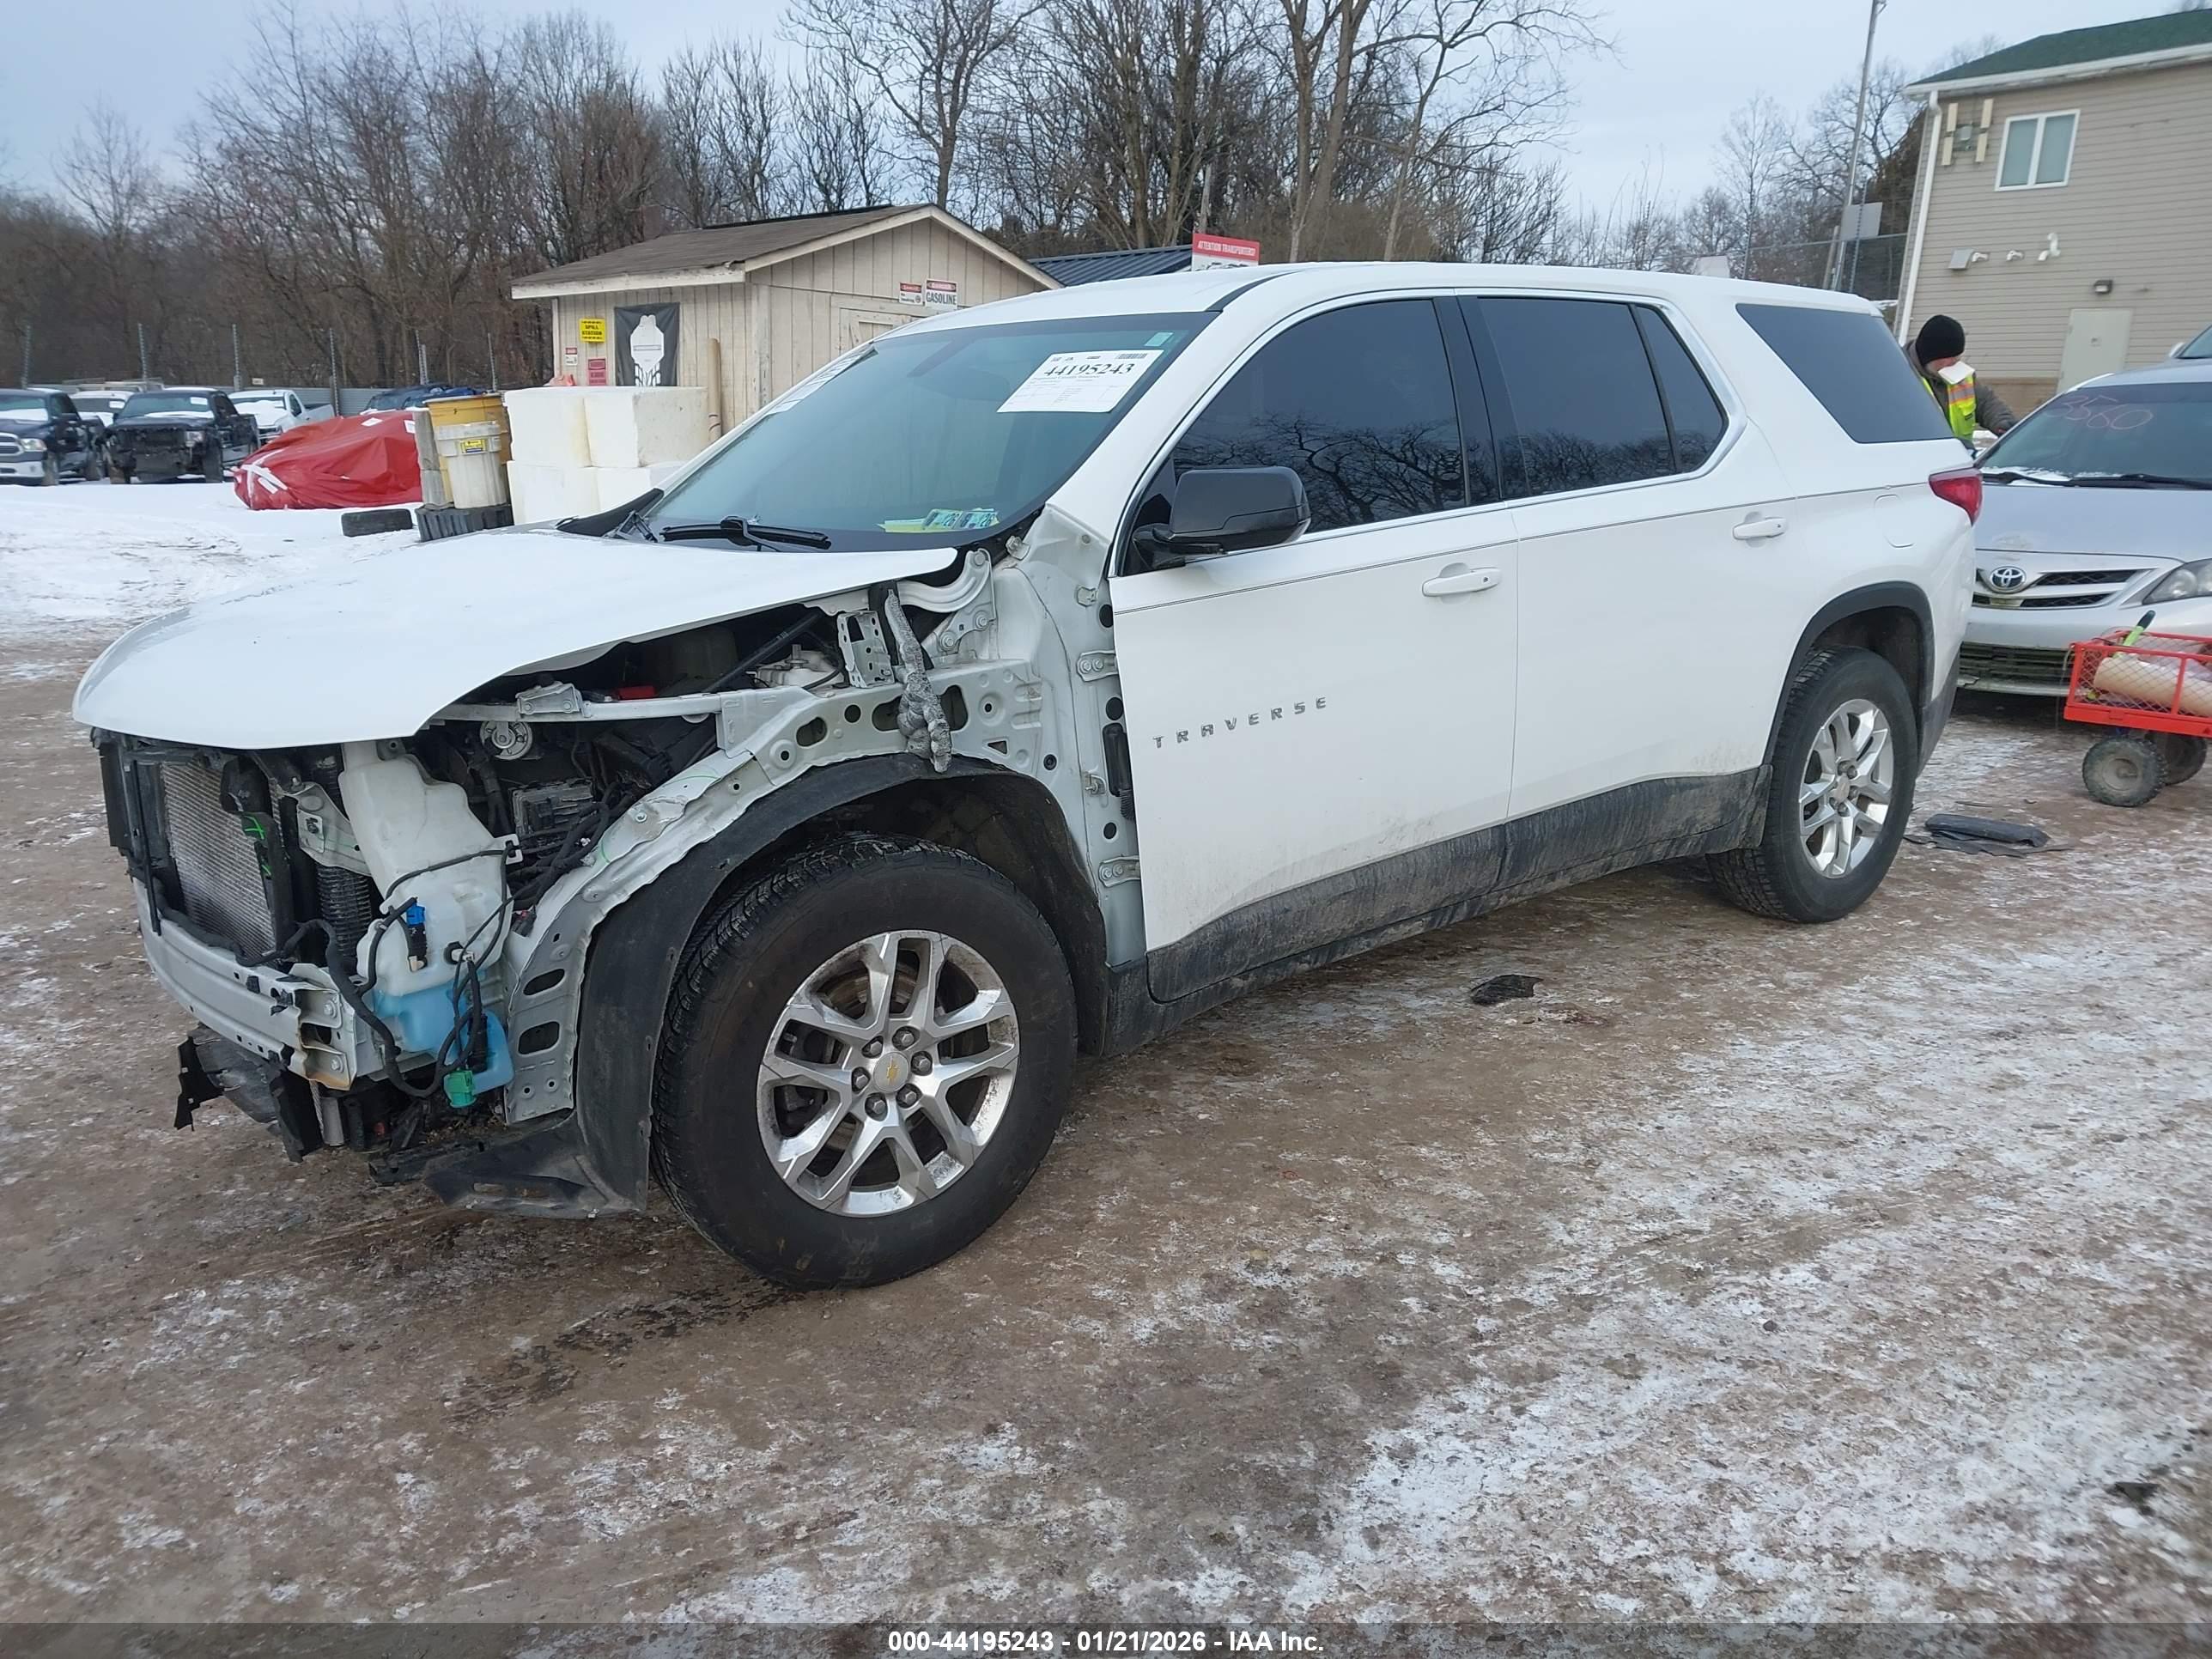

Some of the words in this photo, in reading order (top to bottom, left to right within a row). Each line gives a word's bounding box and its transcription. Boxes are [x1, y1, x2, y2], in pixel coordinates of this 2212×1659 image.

[926, 292, 957, 305] GASOLINE
[1044, 363, 1135, 376] 44195243
[1152, 696, 1327, 749] TRAVERSE
